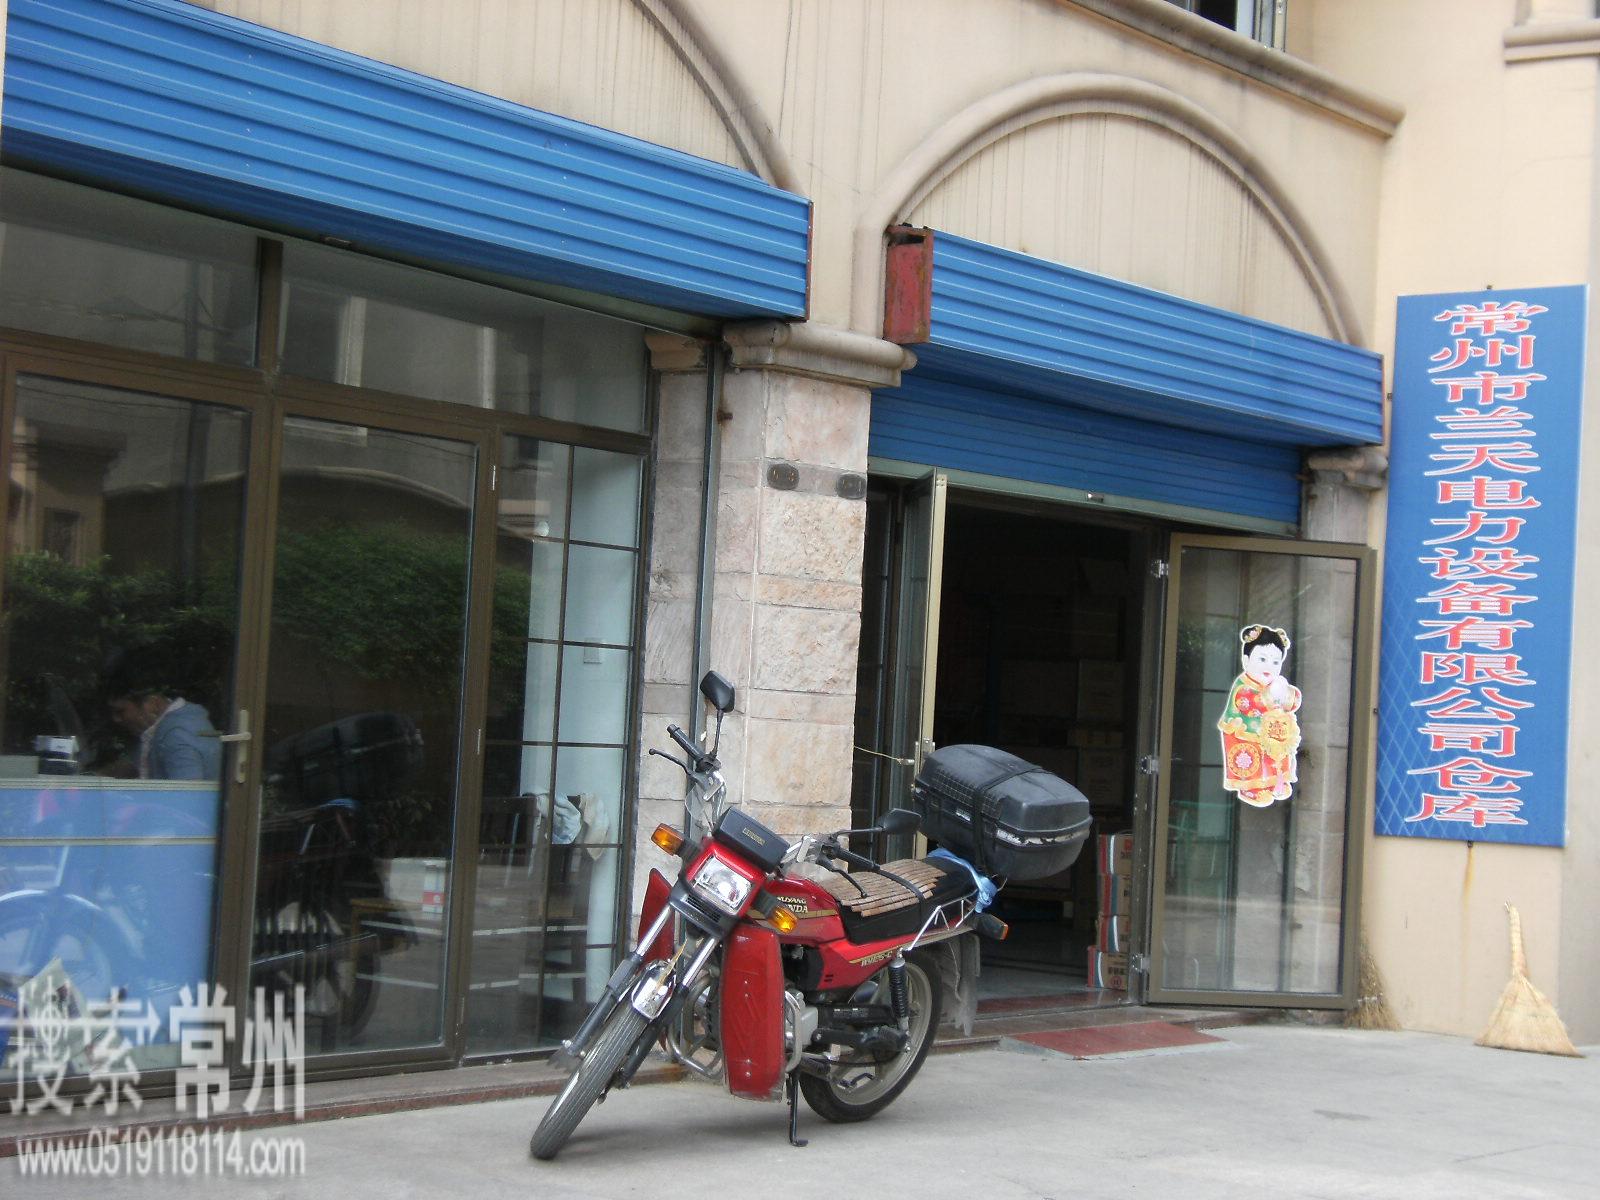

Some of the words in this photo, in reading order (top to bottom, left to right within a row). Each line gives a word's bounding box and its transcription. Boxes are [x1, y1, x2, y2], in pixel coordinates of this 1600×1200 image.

[1404, 300, 1549, 829] 常州市兰天电力设备有限公司仓库
